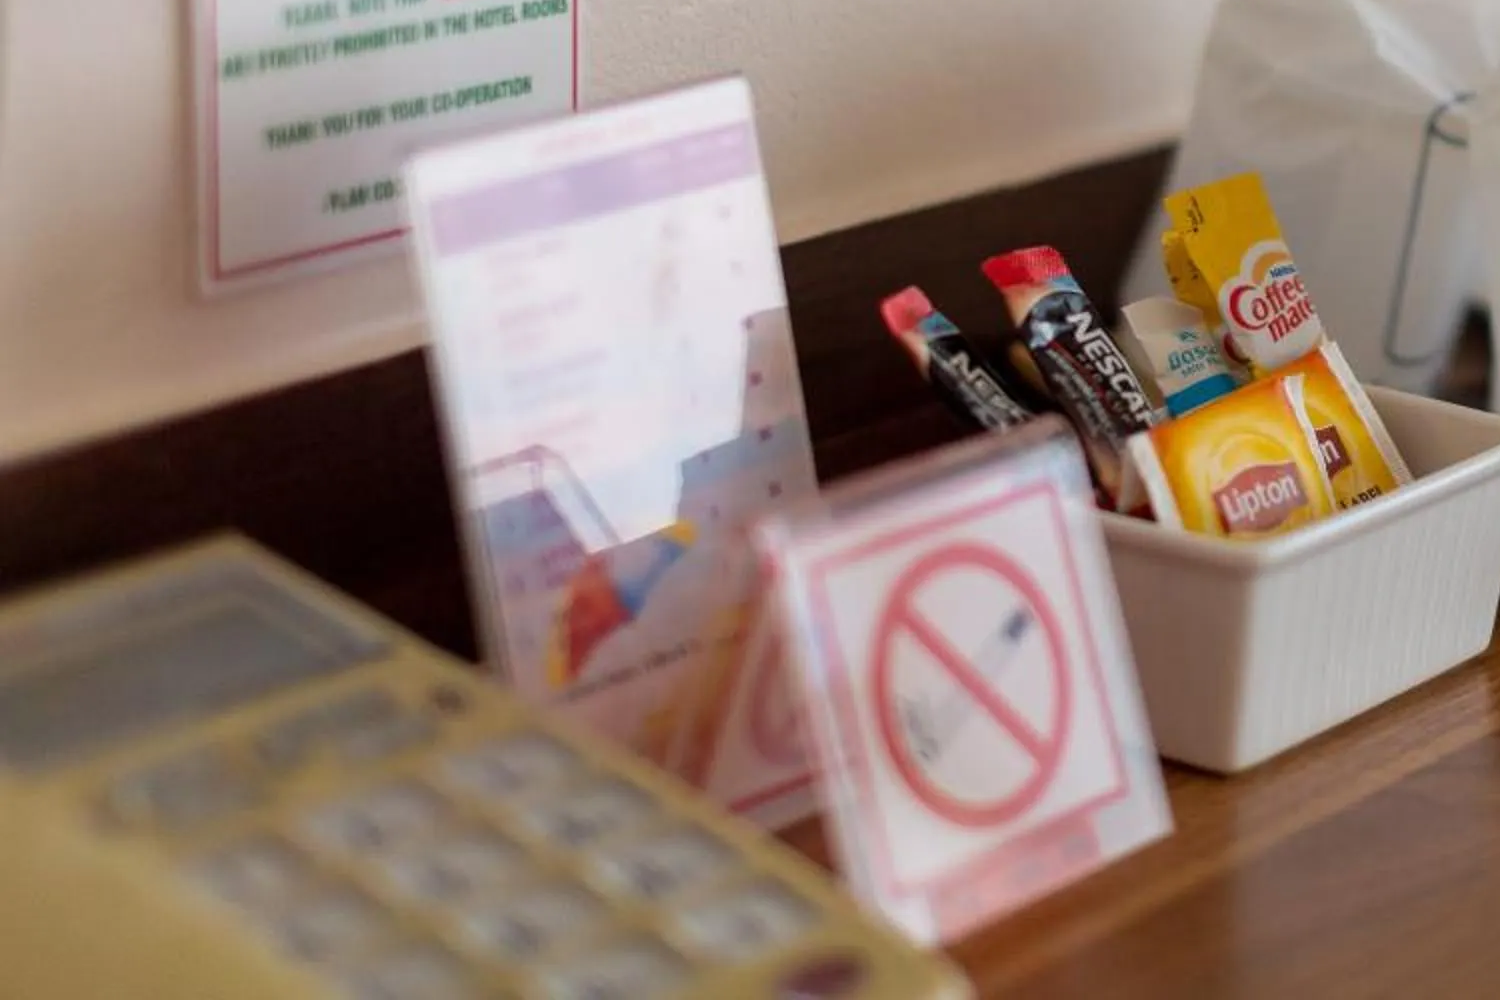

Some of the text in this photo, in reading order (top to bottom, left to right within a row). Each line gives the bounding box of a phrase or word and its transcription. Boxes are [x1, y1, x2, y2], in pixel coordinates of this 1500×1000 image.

[333, 23, 418, 59] PROHIBITED
[442, 13, 468, 36] THE
[474, 4, 516, 30] HOTEL
[266, 76, 533, 151] THANK YOU FOR YOUR CO-OPERATION
[1222, 473, 1298, 522] Lipton
